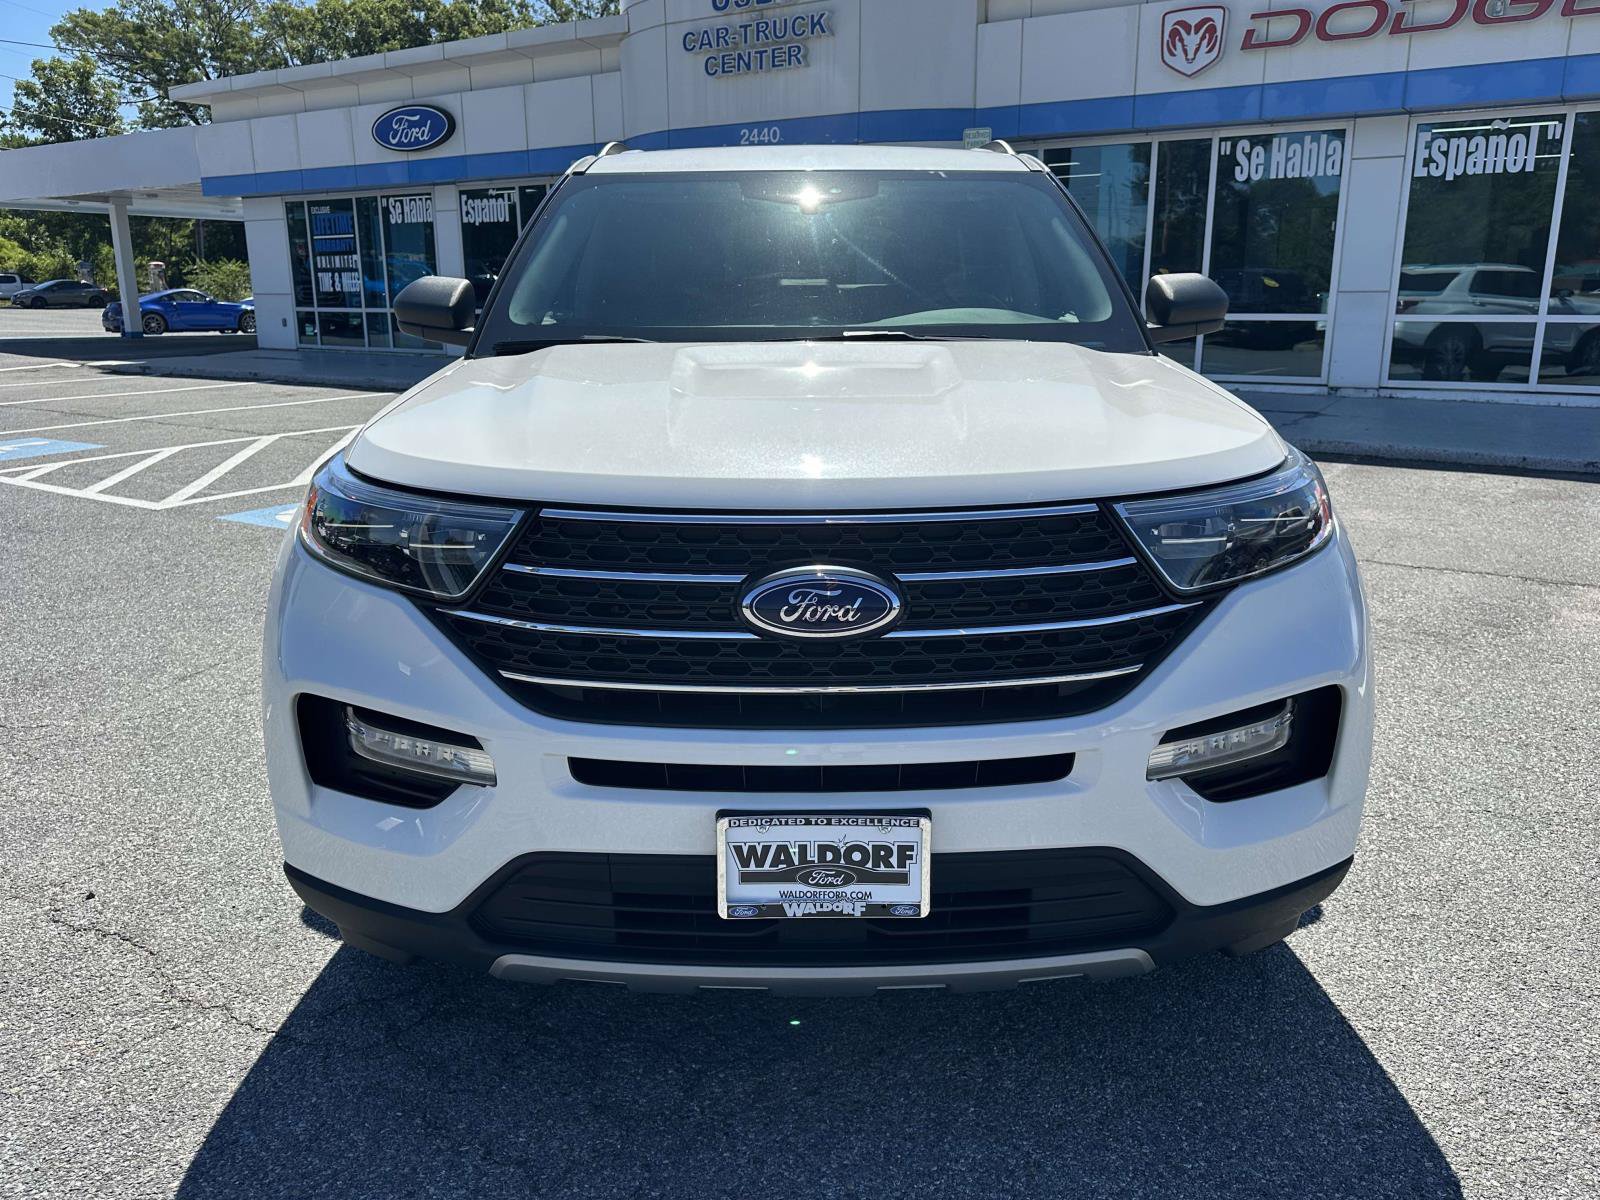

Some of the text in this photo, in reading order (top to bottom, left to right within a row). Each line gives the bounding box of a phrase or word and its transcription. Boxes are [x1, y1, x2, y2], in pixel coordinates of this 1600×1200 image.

[682, 12, 829, 52] CAR-TRUCK
[704, 45, 803, 76] CENTER
[389, 114, 432, 145] Ford
[740, 126, 780, 145] 2440
[1269, 134, 1342, 179] Habla
[403, 195, 433, 224] Habla
[317, 272, 334, 292] TIME
[334, 272, 341, 292] &
[779, 588, 863, 623] Ford
[729, 818, 918, 827] DEDICATED TO EXCELLENCE
[732, 844, 915, 869] WALDORF
[808, 870, 845, 886] Ford
[779, 890, 873, 900] WALDORFFORD.COM
[782, 900, 867, 917] WALDORF
